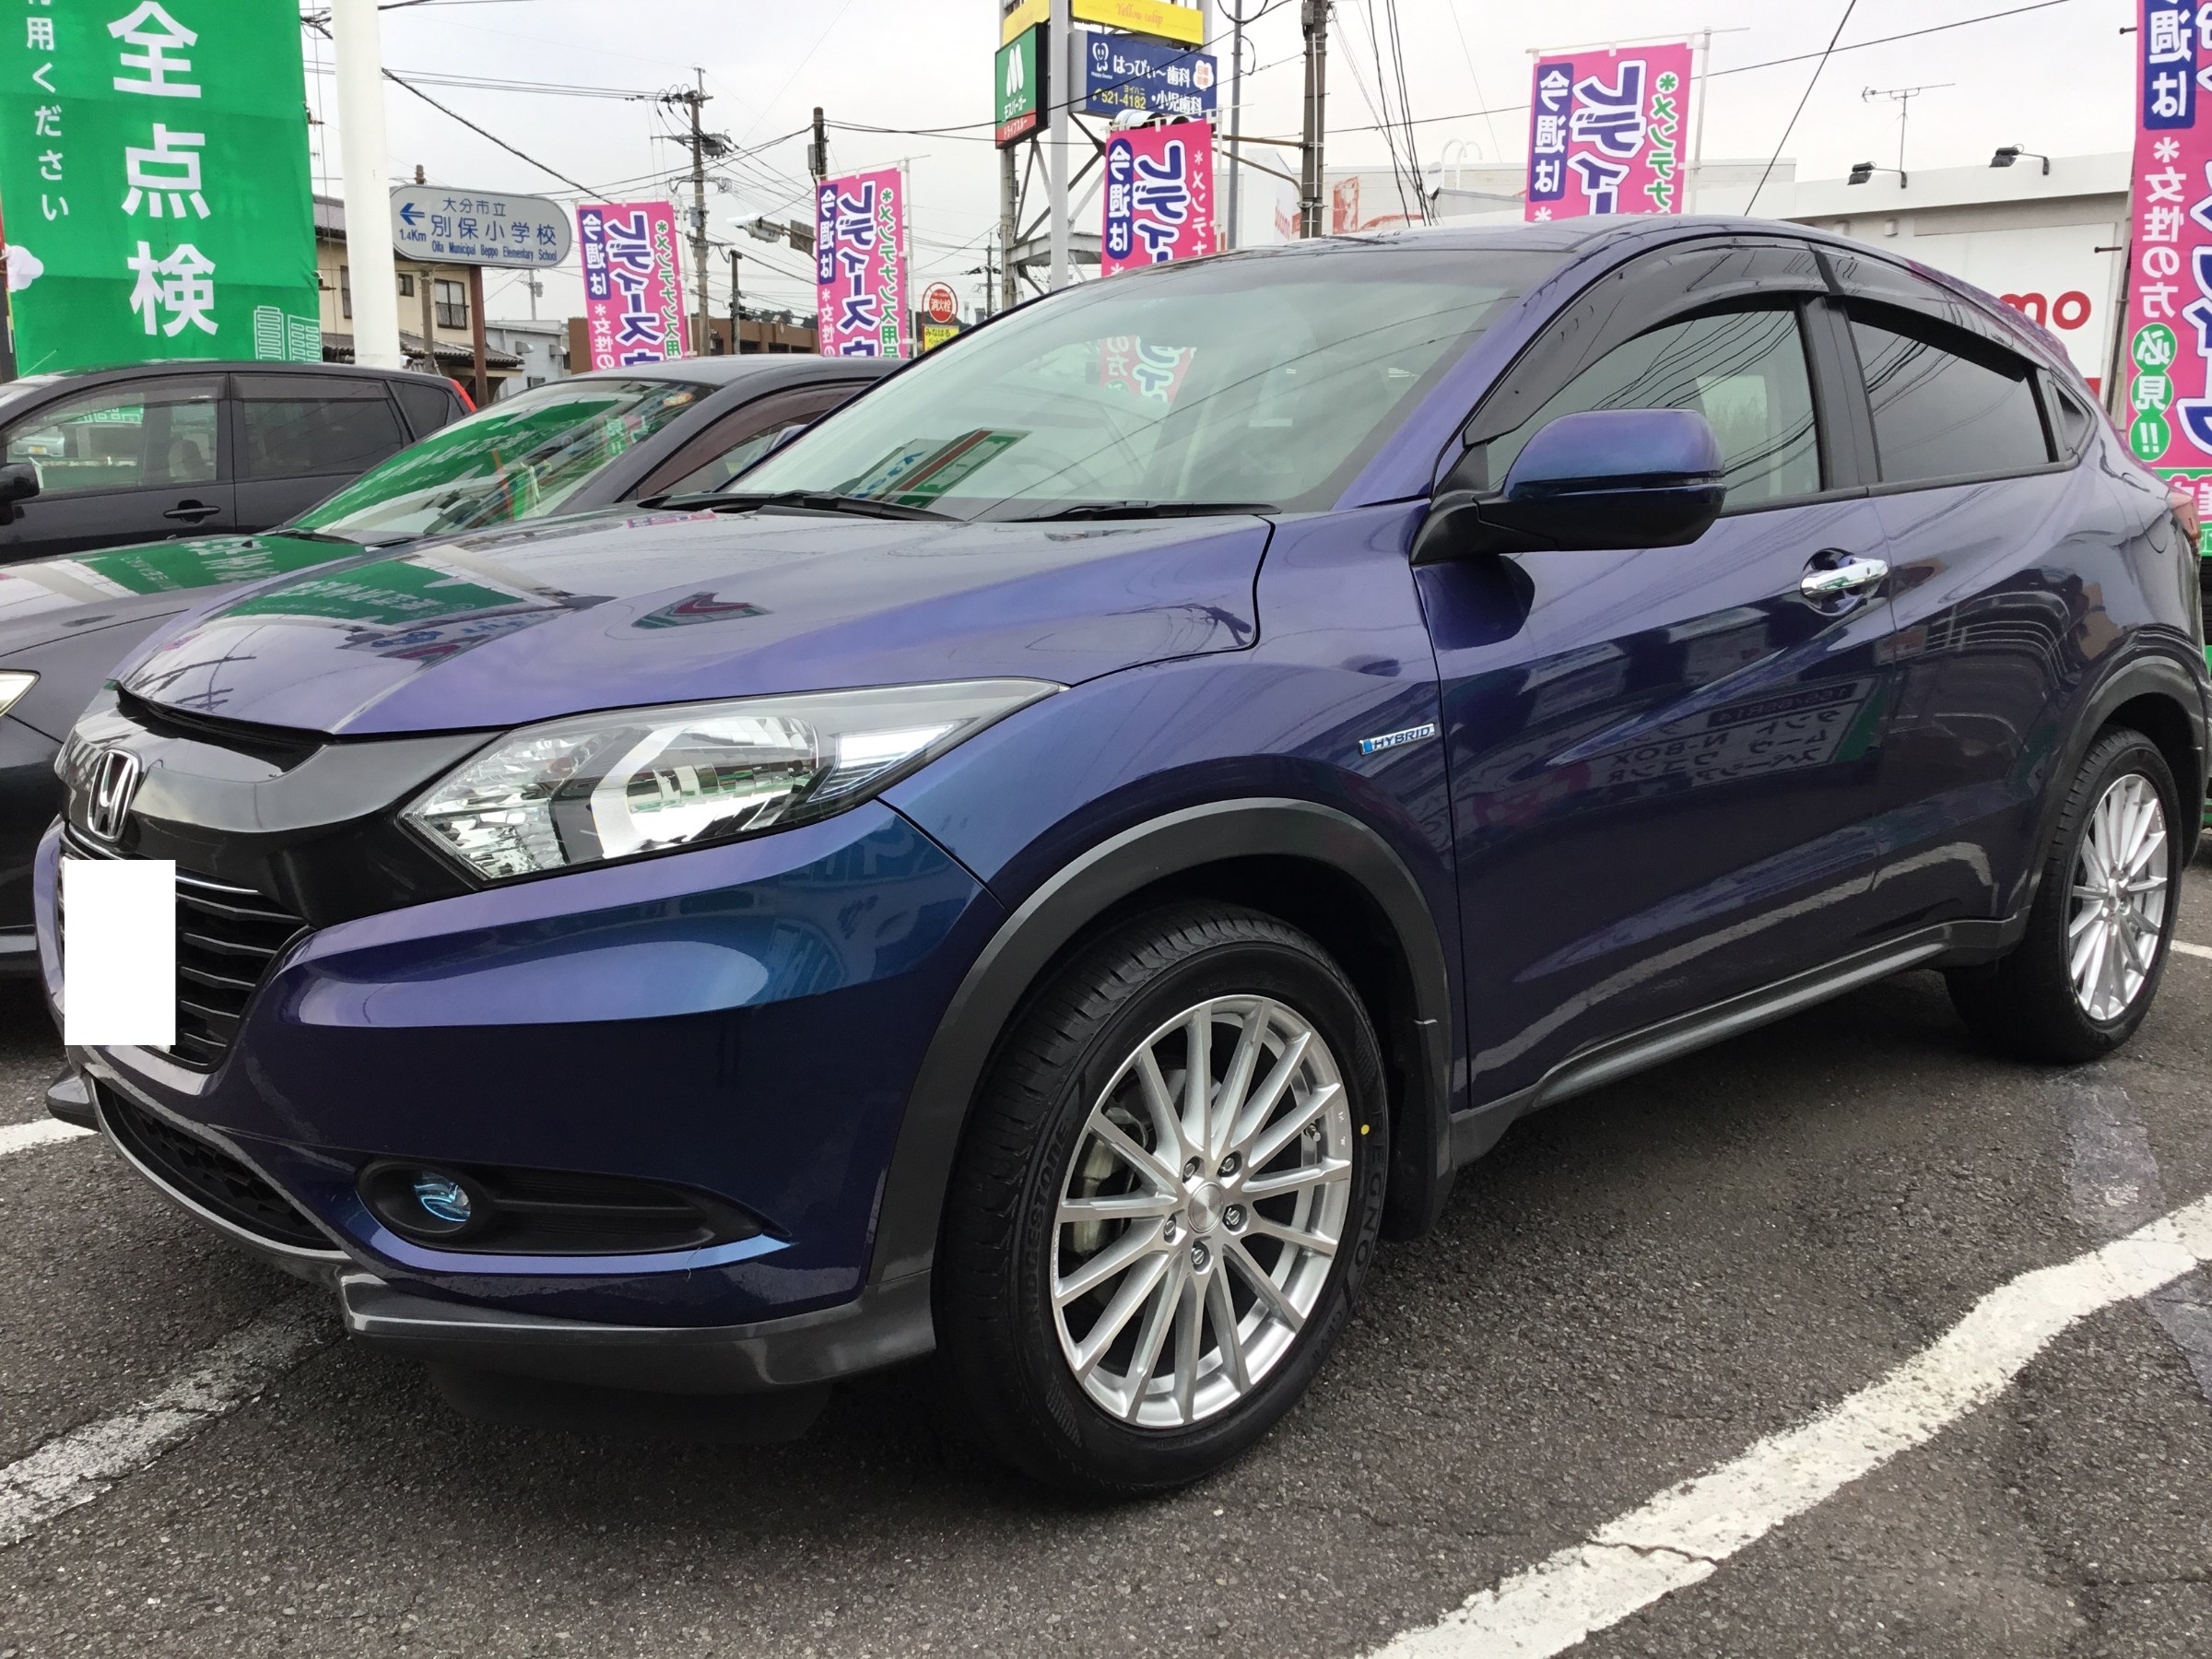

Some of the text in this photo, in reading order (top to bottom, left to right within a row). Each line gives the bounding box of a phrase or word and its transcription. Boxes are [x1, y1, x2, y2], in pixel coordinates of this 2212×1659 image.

[1115, 3, 1143, 20] Yellow
[27, 0, 69, 221] 用ください
[1101, 90, 1147, 110] 521-4182
[106, 1, 219, 337] 全点検
[442, 196, 507, 218] 大分市立
[399, 228, 427, 242] 1.4Km
[430, 214, 557, 247] 別保小学校
[431, 241, 558, 262] Oita Municipal Beppo Elementary School
[931, 298, 952, 312] 消火栓
[1373, 726, 1430, 749] HYBRID
